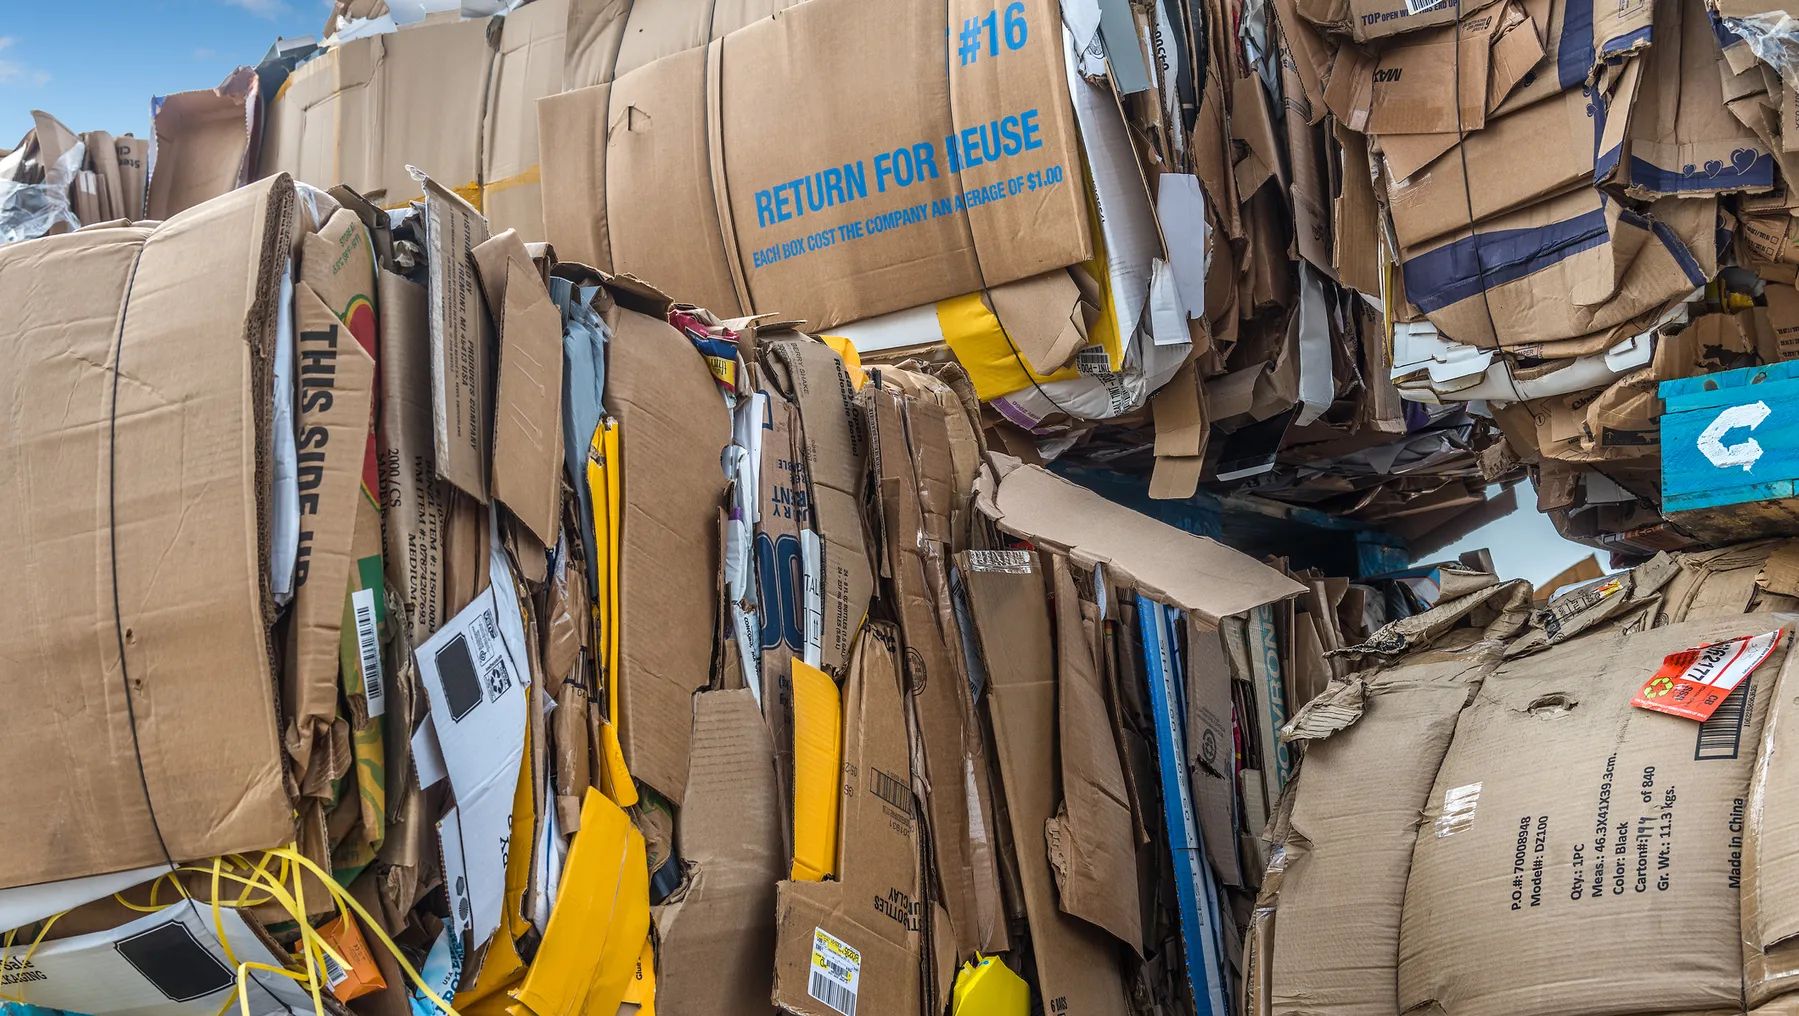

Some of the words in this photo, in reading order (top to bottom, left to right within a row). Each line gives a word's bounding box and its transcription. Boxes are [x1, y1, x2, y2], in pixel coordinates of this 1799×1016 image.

[1361, 12, 1381, 26] TOP
[1381, 10, 1399, 22] OPEN
[1434, 1, 1447, 11] END
[958, 2, 1028, 66] #16
[754, 160, 868, 228] RETURN
[873, 142, 939, 193] FOR
[945, 109, 1042, 174] REUSE
[752, 243, 781, 269] EACH
[783, 237, 806, 259] BOX
[807, 228, 836, 252] COST
[838, 221, 865, 242] THE
[865, 203, 928, 236] COMPANY
[931, 200, 952, 218] AN
[953, 181, 1006, 213] AERAGE
[1008, 175, 1024, 195] OF
[1027, 165, 1063, 192] $1.00
[466, 280, 472, 295] BY
[460, 316, 466, 332] MI
[300, 323, 339, 414] THIS
[468, 339, 476, 397] PRODUCTS
[790, 342, 804, 367] BERRY
[800, 367, 810, 395] SHAKE
[833, 358, 851, 417] Reclosable
[847, 419, 859, 458] Bottle!
[469, 398, 477, 451] COMPANY
[299, 425, 330, 517] SIDE
[388, 448, 400, 477] 2000
[415, 455, 424, 479] WM
[389, 488, 402, 508] CS
[416, 484, 427, 525] ITEM
[418, 529, 427, 541] #:
[428, 515, 437, 551] ITEM
[407, 532, 417, 600] MEDIUM
[429, 554, 437, 567] #:
[837, 566, 843, 575] 24
[843, 568, 849, 577] 24
[418, 543, 429, 625] 07874207693
[843, 587, 849, 595] FL
[428, 571, 437, 635] H5010004
[1704, 694, 1719, 706] CB
[1642, 766, 1656, 788] 840
[1595, 752, 1618, 852] 46.3X41X39.3cm.
[1641, 792, 1652, 803] of
[1661, 785, 1677, 810] kgs.
[1660, 812, 1673, 839] 11.3
[1728, 798, 1744, 835] China
[1534, 815, 1549, 853] DZ100
[1615, 821, 1629, 855] Black
[1729, 836, 1743, 850] in
[1573, 844, 1585, 868] 1PC
[1635, 838, 1650, 893] Carton#:
[1658, 842, 1672, 870] Wt.:
[1728, 854, 1742, 889] Made
[1530, 855, 1543, 907] Model#:
[1570, 871, 1583, 901] Qty.:
[1592, 855, 1605, 898] Meas.:
[1613, 857, 1626, 896] Color:
[1657, 872, 1670, 892] Gr.
[442, 972, 454, 986] USA
[635, 961, 643, 981] Glue
